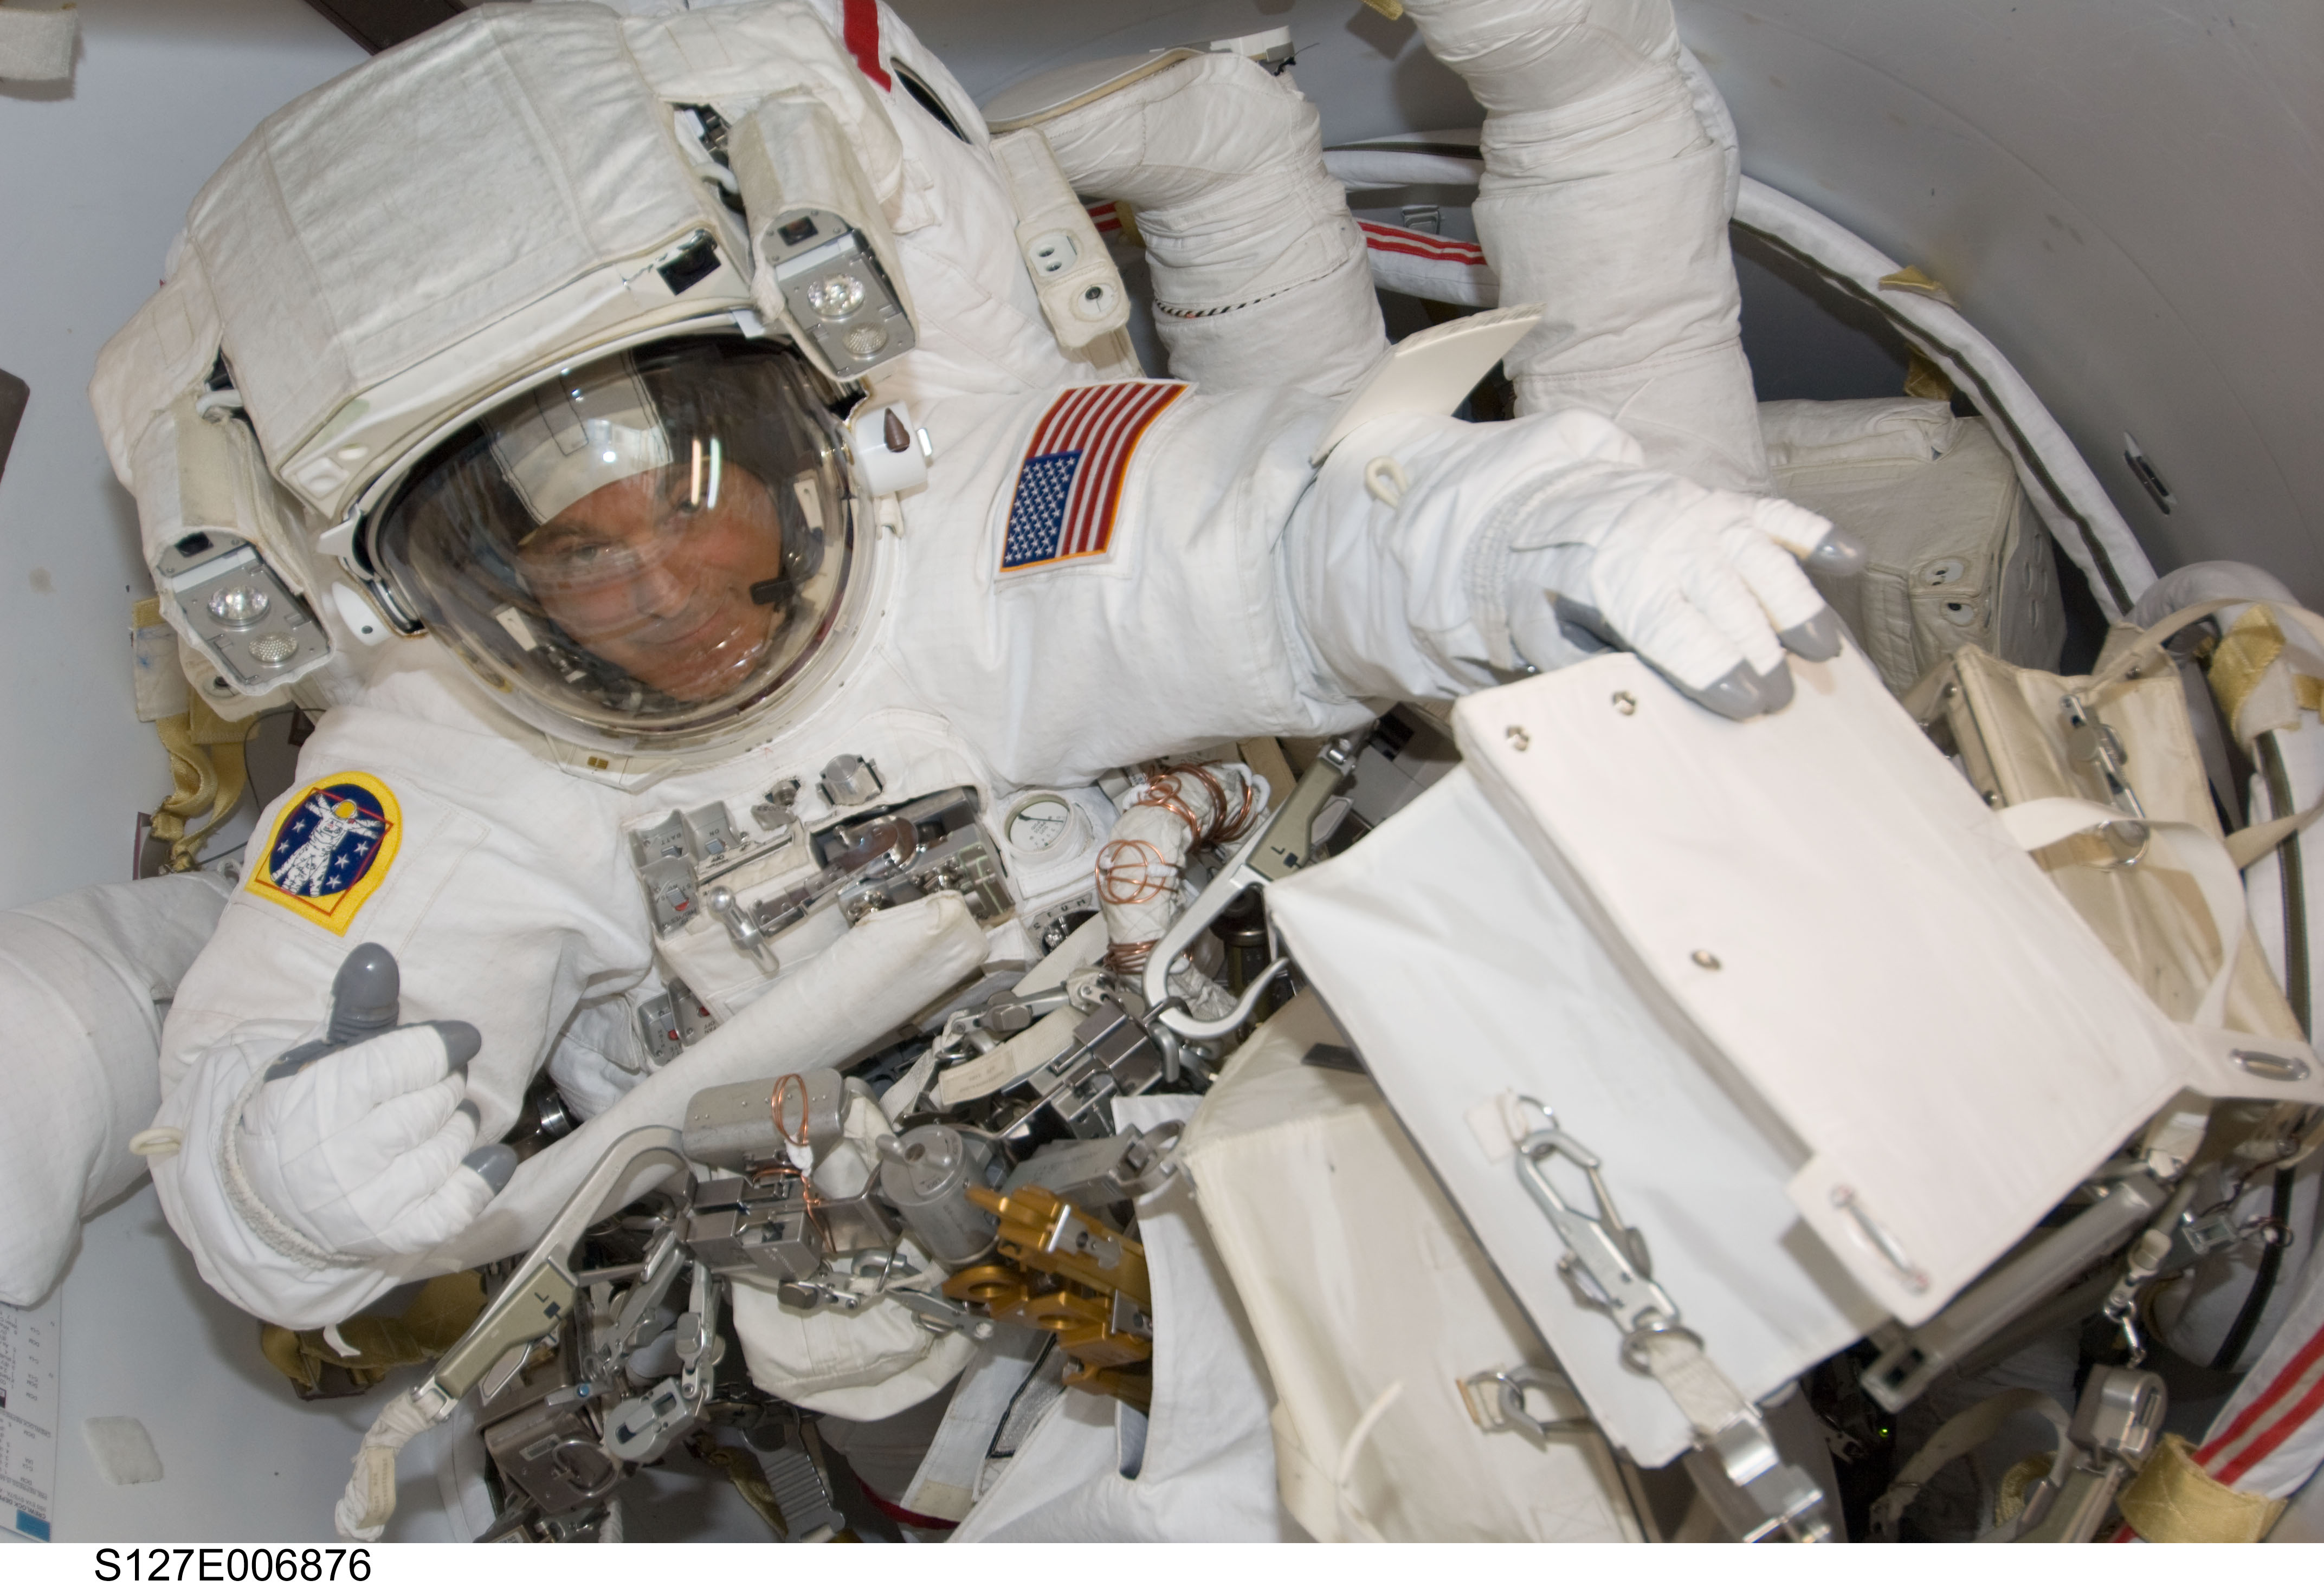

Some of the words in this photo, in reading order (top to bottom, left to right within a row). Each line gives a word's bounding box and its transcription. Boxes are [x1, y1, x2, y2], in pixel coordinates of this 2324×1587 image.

[660, 832, 682, 846] BATT
[709, 828, 720, 837] ON
[13, 1502, 47, 1520] CREWLOCK
